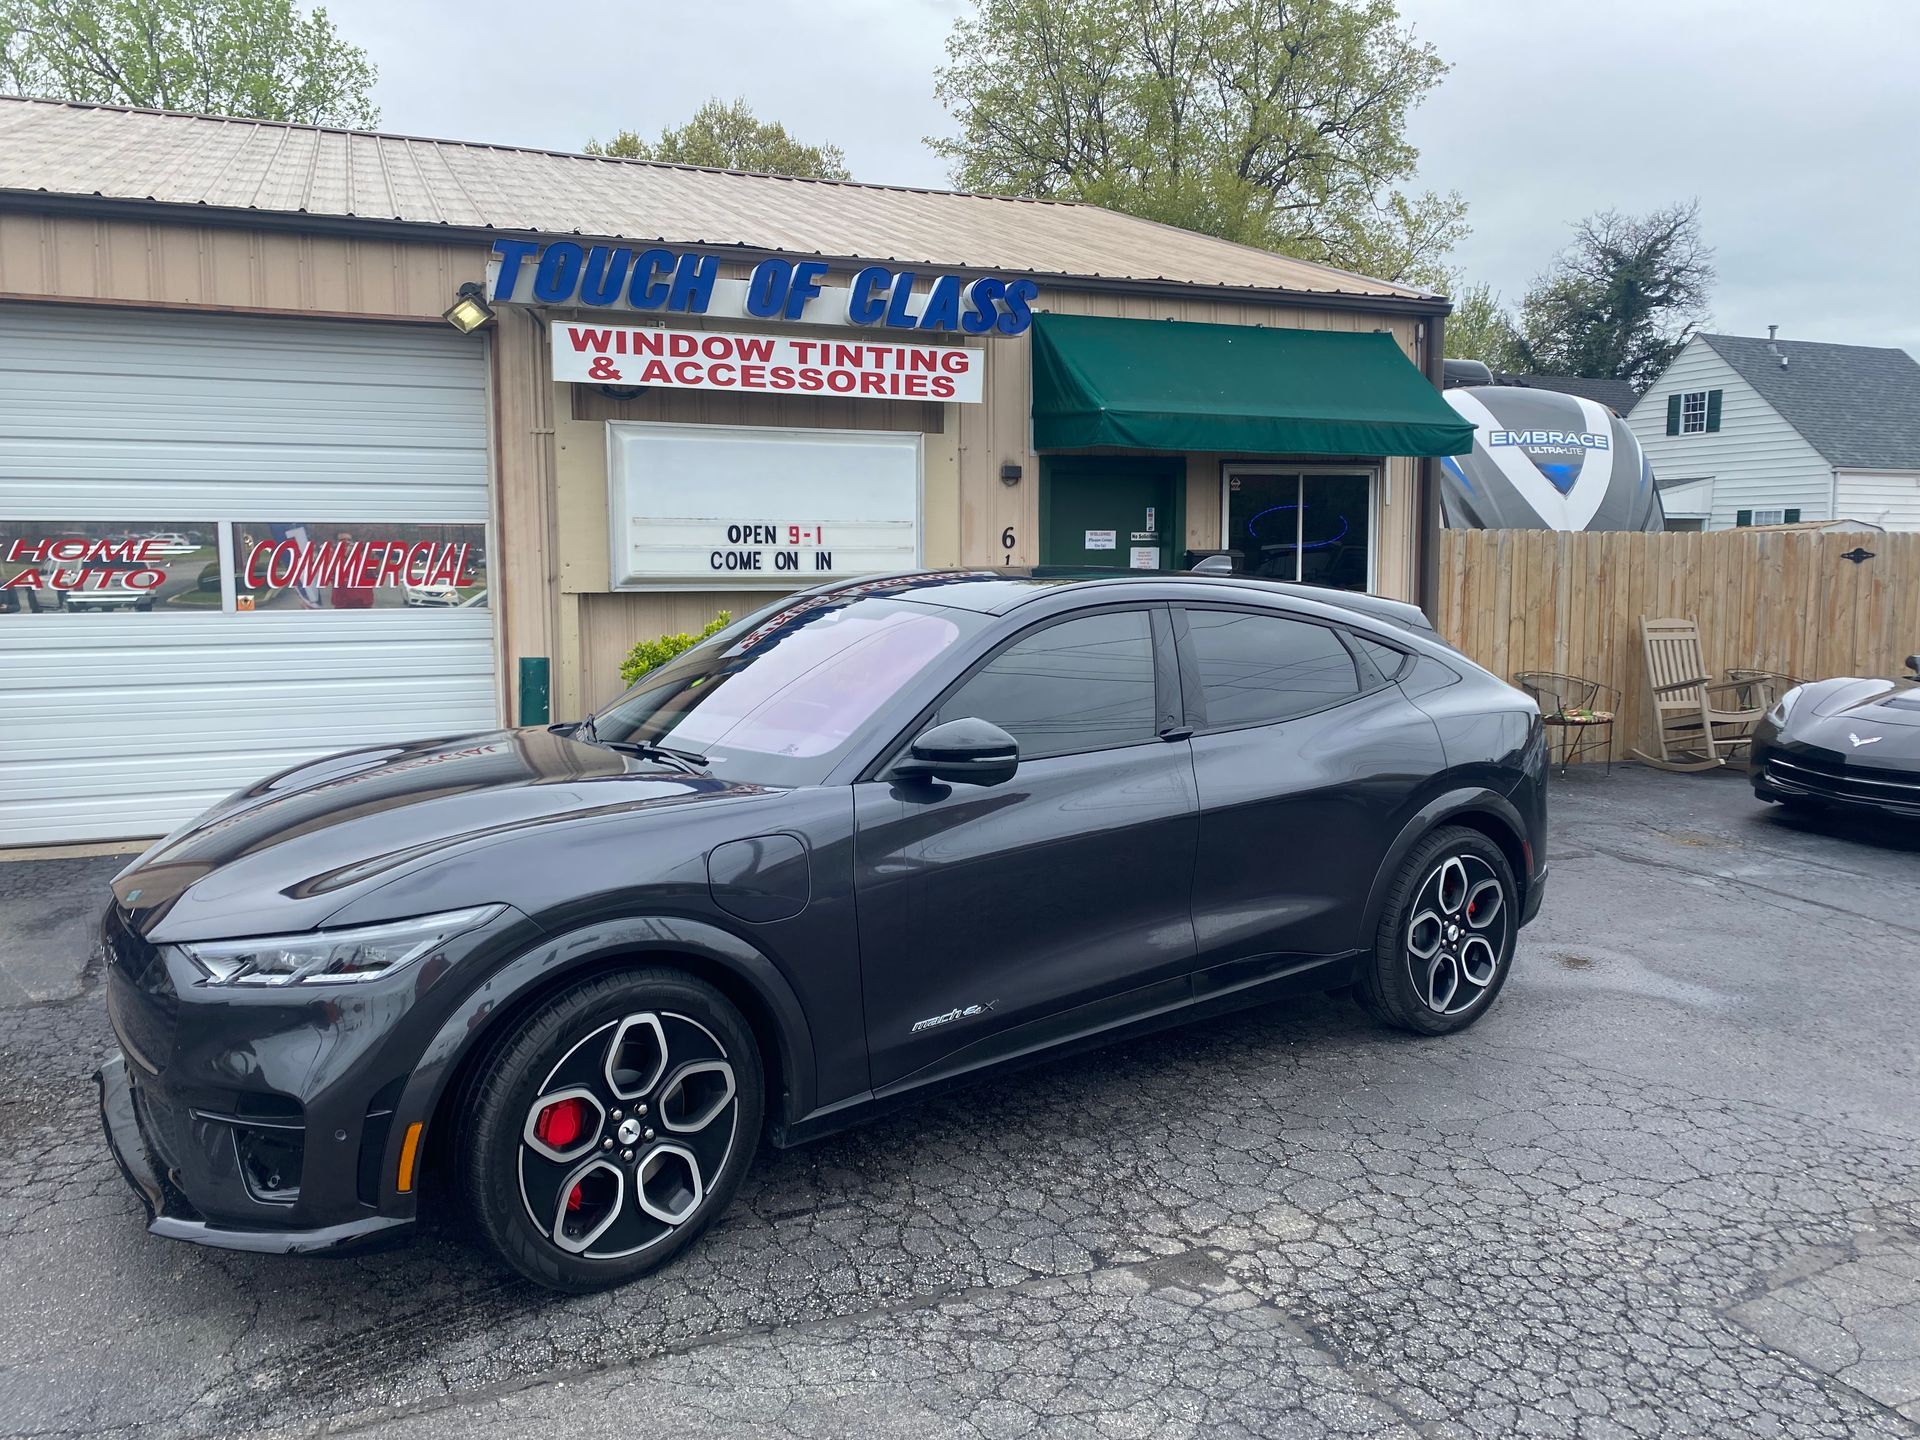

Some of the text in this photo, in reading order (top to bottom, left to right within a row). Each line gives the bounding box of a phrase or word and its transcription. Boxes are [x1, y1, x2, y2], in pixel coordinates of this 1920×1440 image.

[491, 237, 1038, 337] TOUCH OF CLASS
[568, 327, 970, 374] WINDOW TINTING
[588, 356, 957, 399] & ACCESSORIES
[1490, 431, 1608, 448] EMBRACE
[1529, 446, 1583, 455] ULTRA-LITE
[727, 524, 823, 545] OPEN 9-1
[6, 537, 170, 563] HOME
[710, 550, 833, 571] COME ON IN
[244, 540, 476, 590] COMMERCIAL
[0, 568, 168, 591] AUTO
